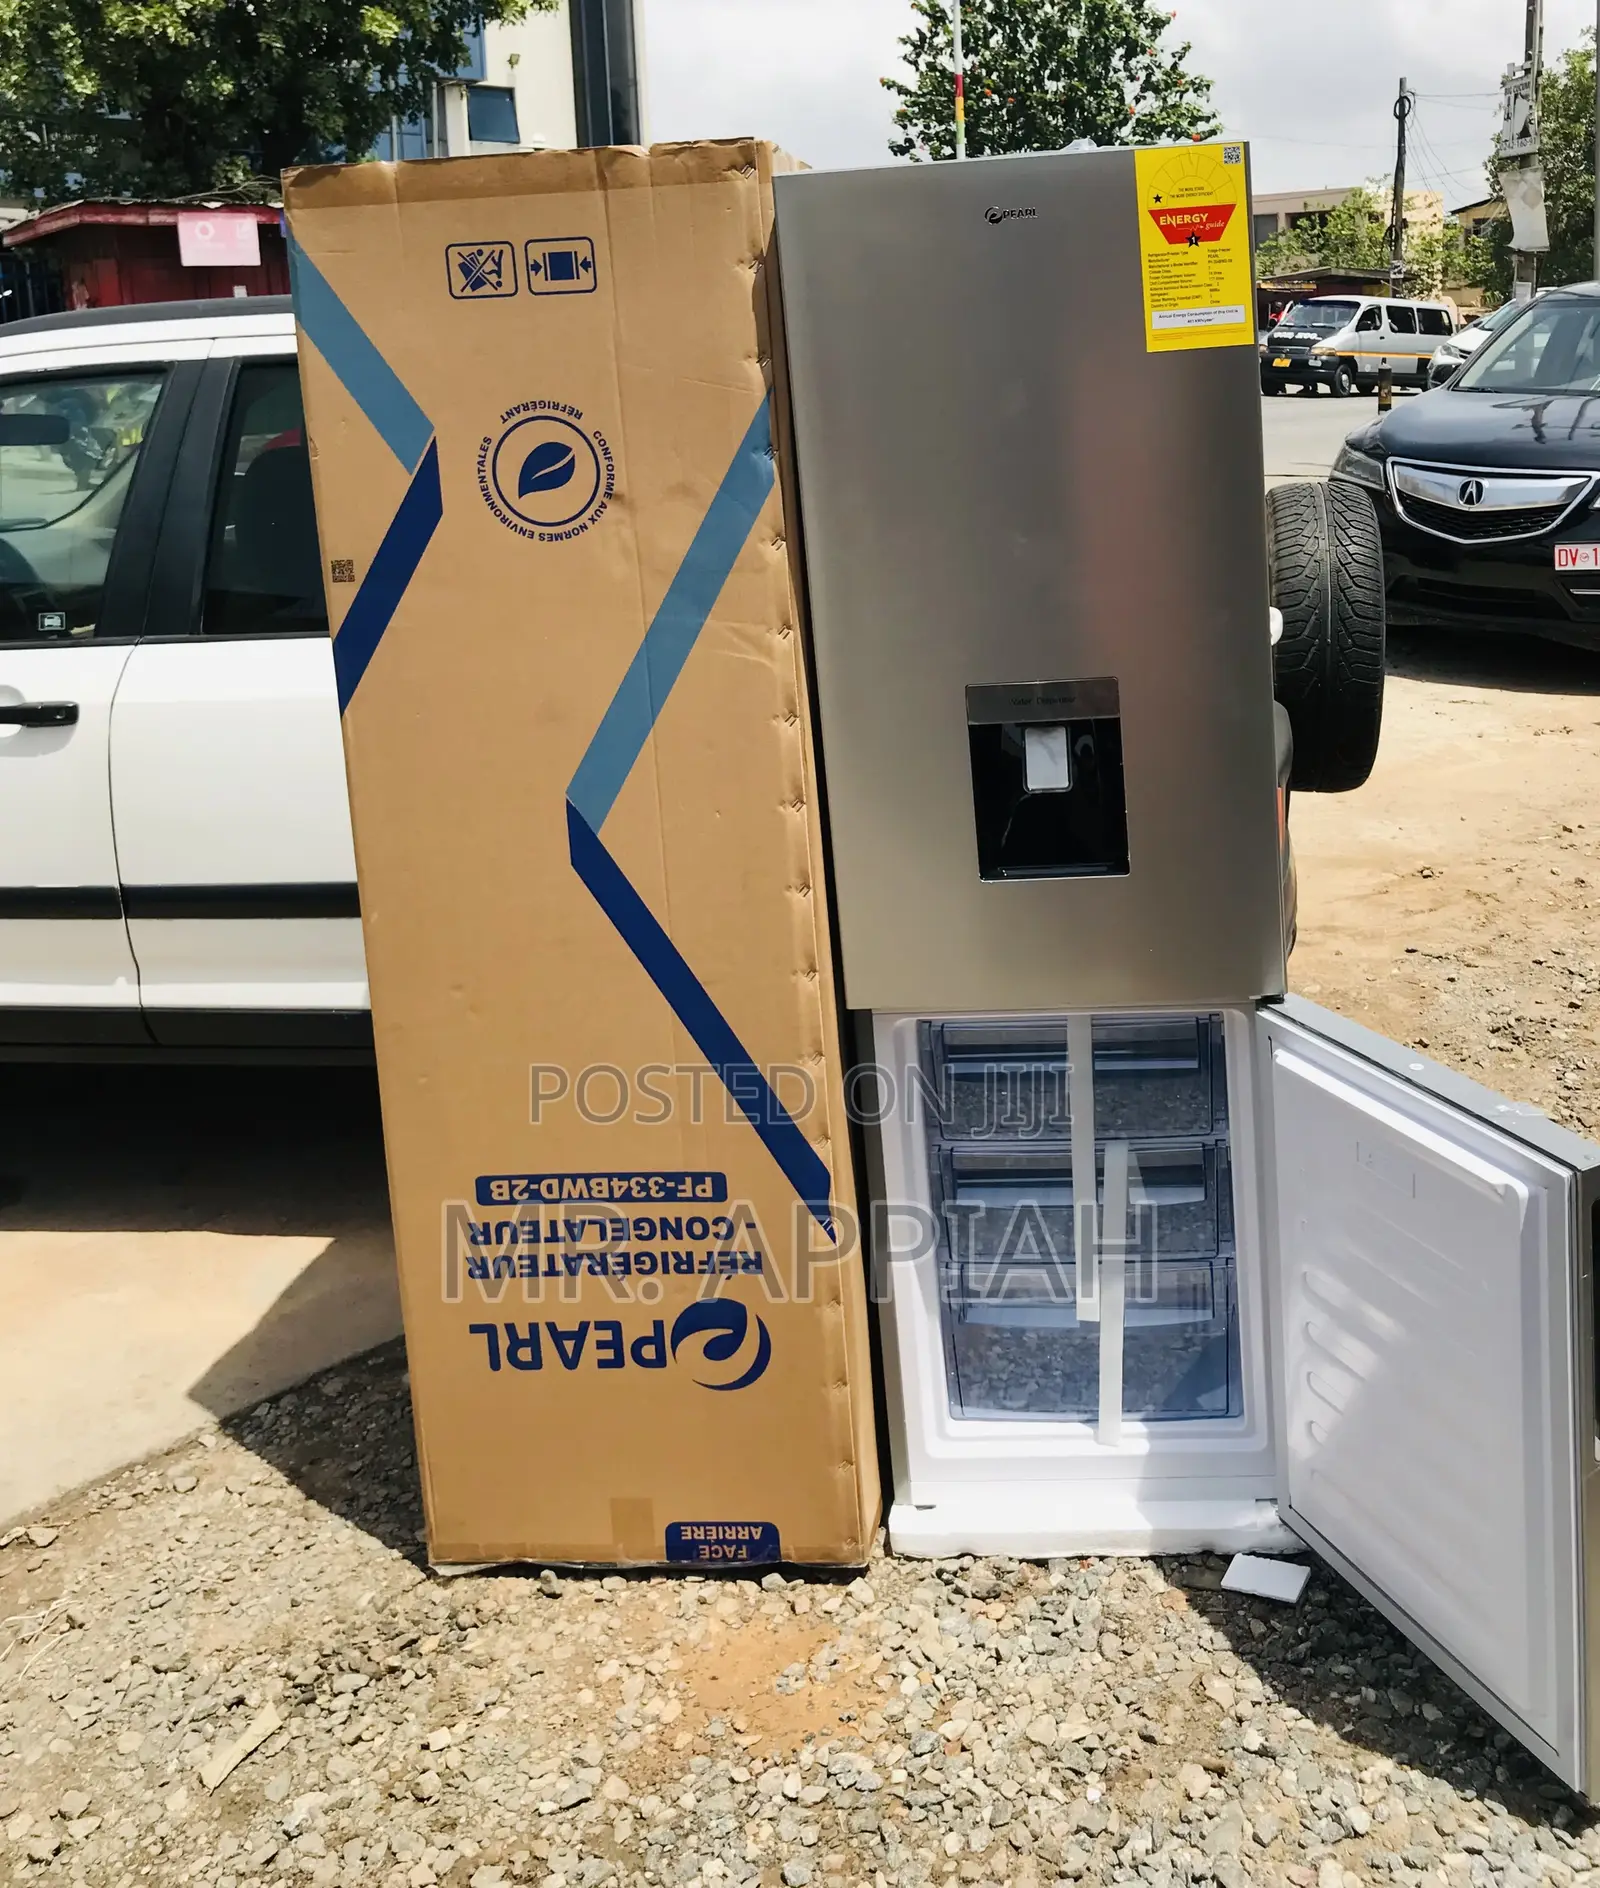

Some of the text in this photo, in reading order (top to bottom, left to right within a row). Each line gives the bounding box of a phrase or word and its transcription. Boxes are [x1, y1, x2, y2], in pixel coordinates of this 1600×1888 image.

[1003, 207, 1039, 219] PEARL
[1159, 213, 1208, 228] ENERGY
[1205, 220, 1225, 230] guide
[500, 399, 584, 425] RÉFRIGÉRANT
[476, 430, 615, 542] CONFORME AUX NORMES ENVIRONMENTALES
[1558, 547, 1598, 567] DV 1
[489, 1176, 714, 1201] PF-334BWD-2B
[466, 1250, 763, 1281] RÉFRIGÉRATEUR
[469, 1320, 668, 1371] PEARL
[680, 1525, 763, 1543] ARRIÈRE
[698, 1544, 748, 1559] FACE
